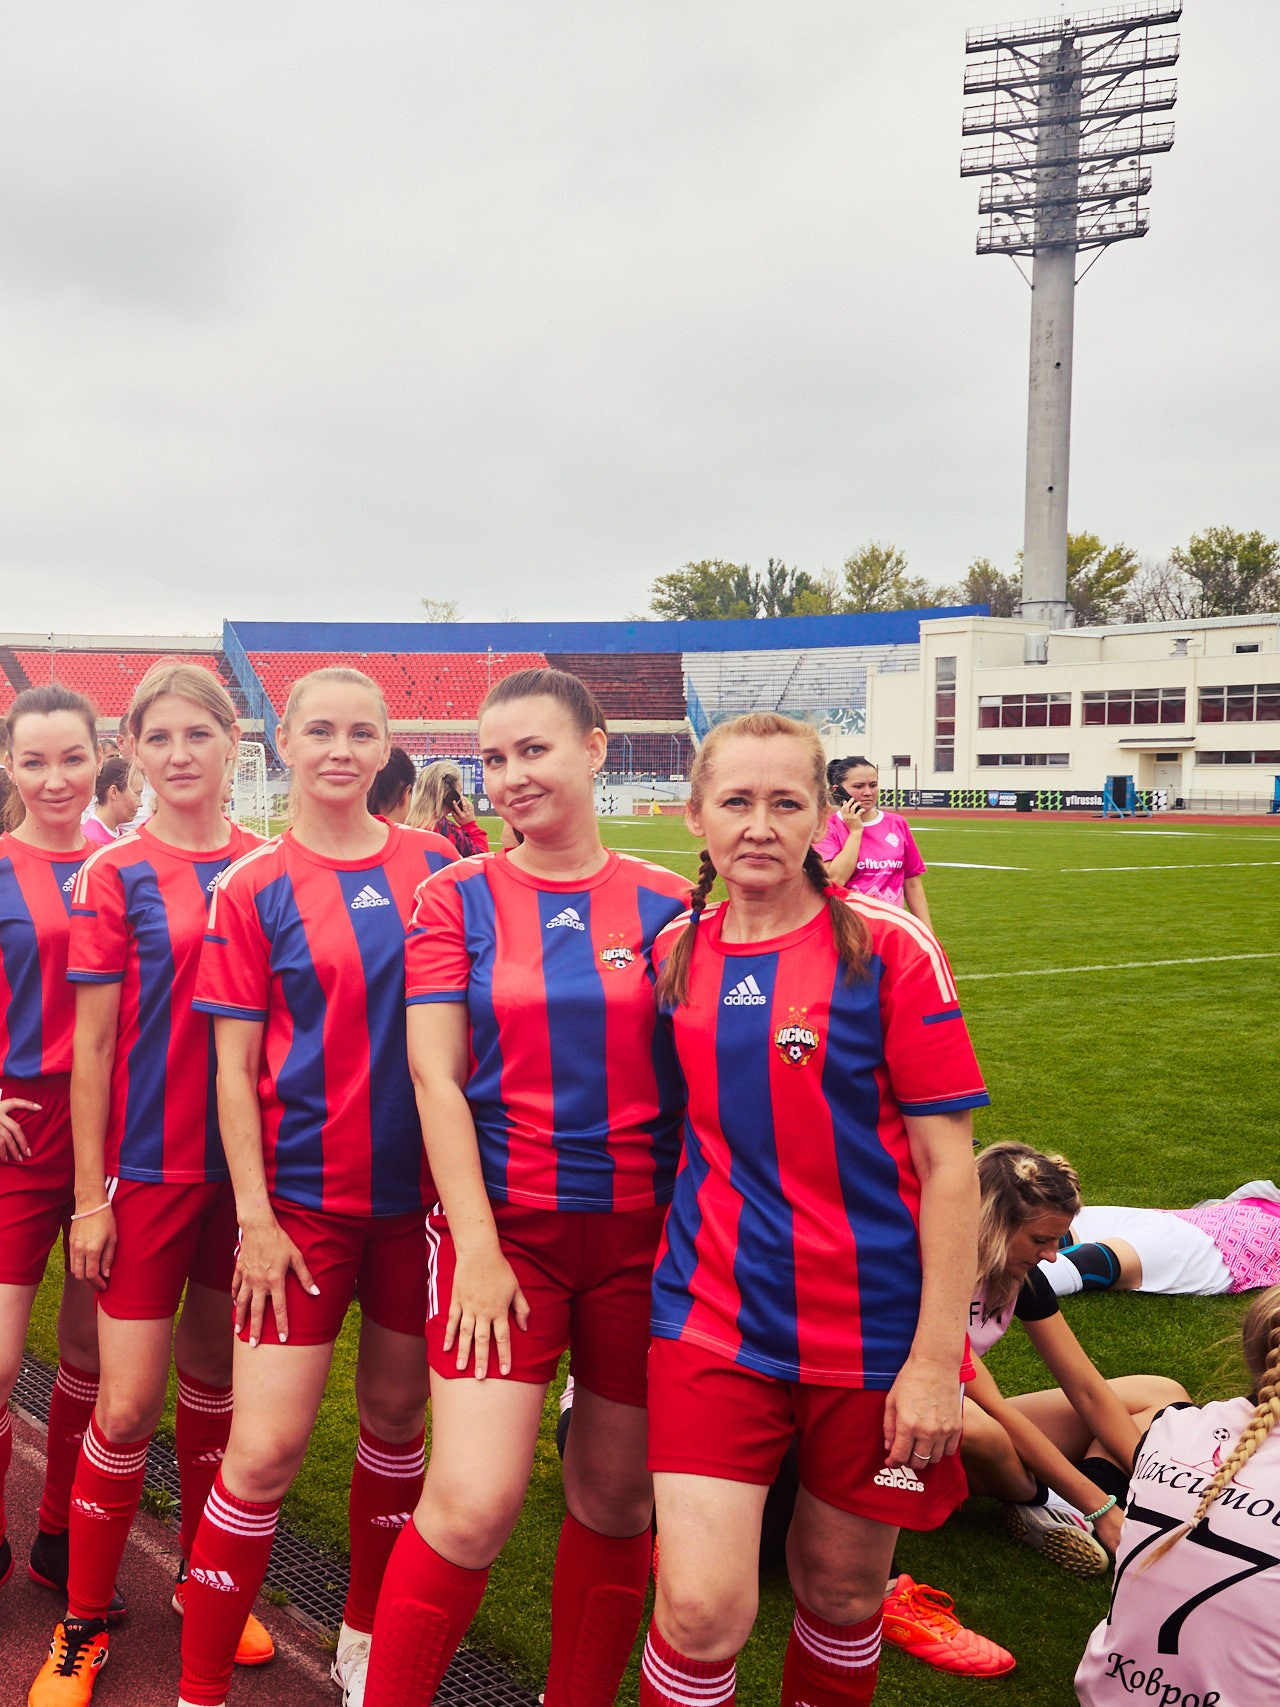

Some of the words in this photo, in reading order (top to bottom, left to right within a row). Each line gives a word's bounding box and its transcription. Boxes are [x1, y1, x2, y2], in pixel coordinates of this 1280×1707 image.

[351, 898, 390, 909] adidas
[546, 918, 585, 931] adidas
[602, 947, 634, 961] ЦСКА
[724, 994, 767, 1006] adidas
[776, 1027, 816, 1046] ЦСКА
[873, 1474, 925, 1492] adidas
[191, 1568, 239, 1592] adidas
[1106, 1493, 1280, 1655] 77
